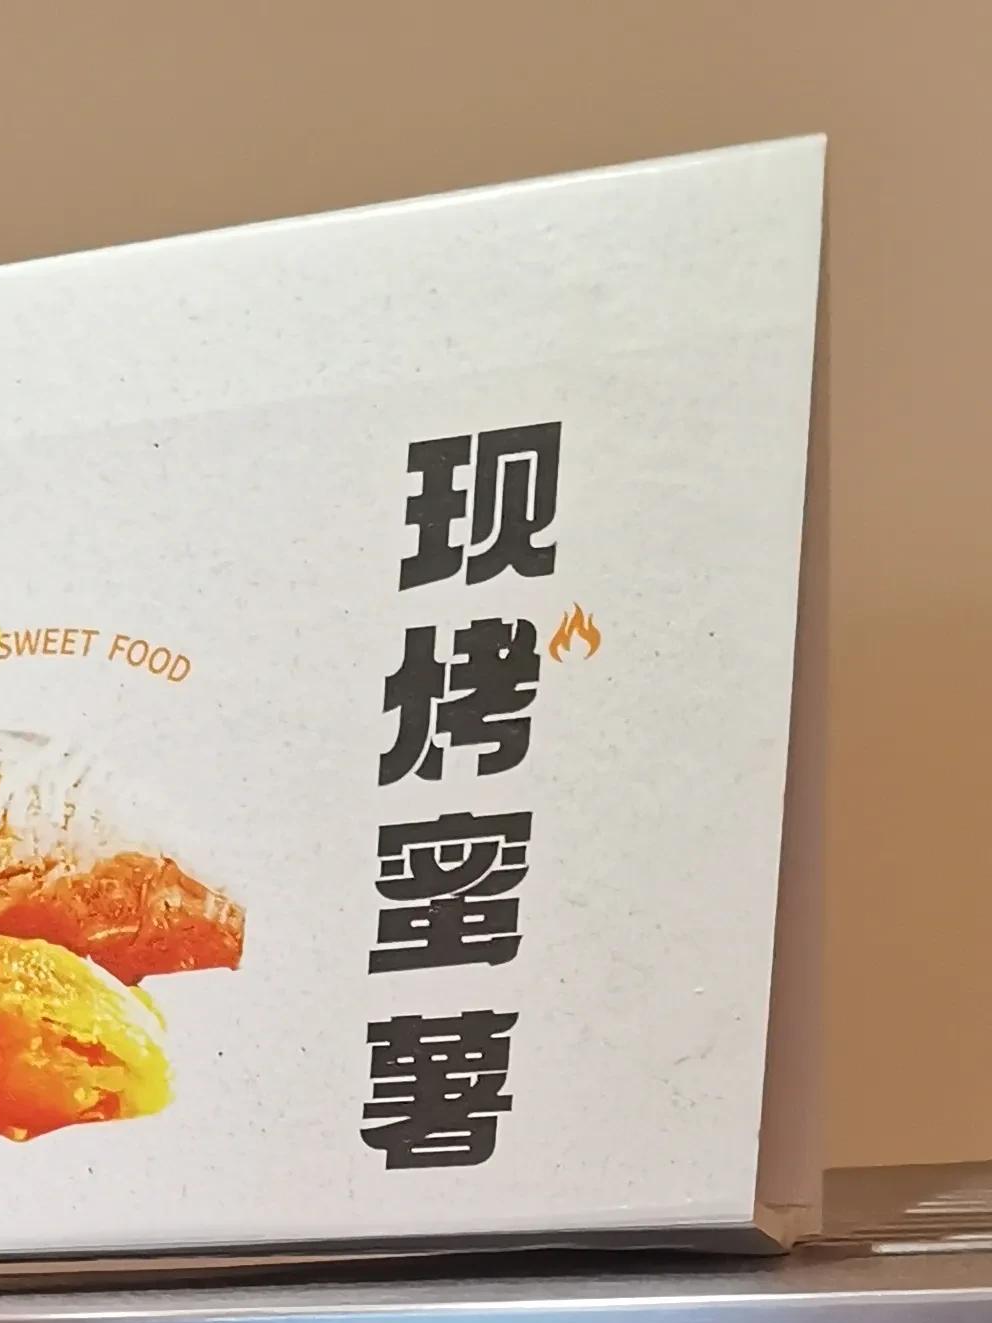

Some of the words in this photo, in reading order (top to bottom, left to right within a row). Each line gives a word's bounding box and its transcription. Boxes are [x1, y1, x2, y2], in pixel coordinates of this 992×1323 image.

[108, 633, 192, 682] FOOD
[359, 421, 563, 1170] 现烤蜜薯
